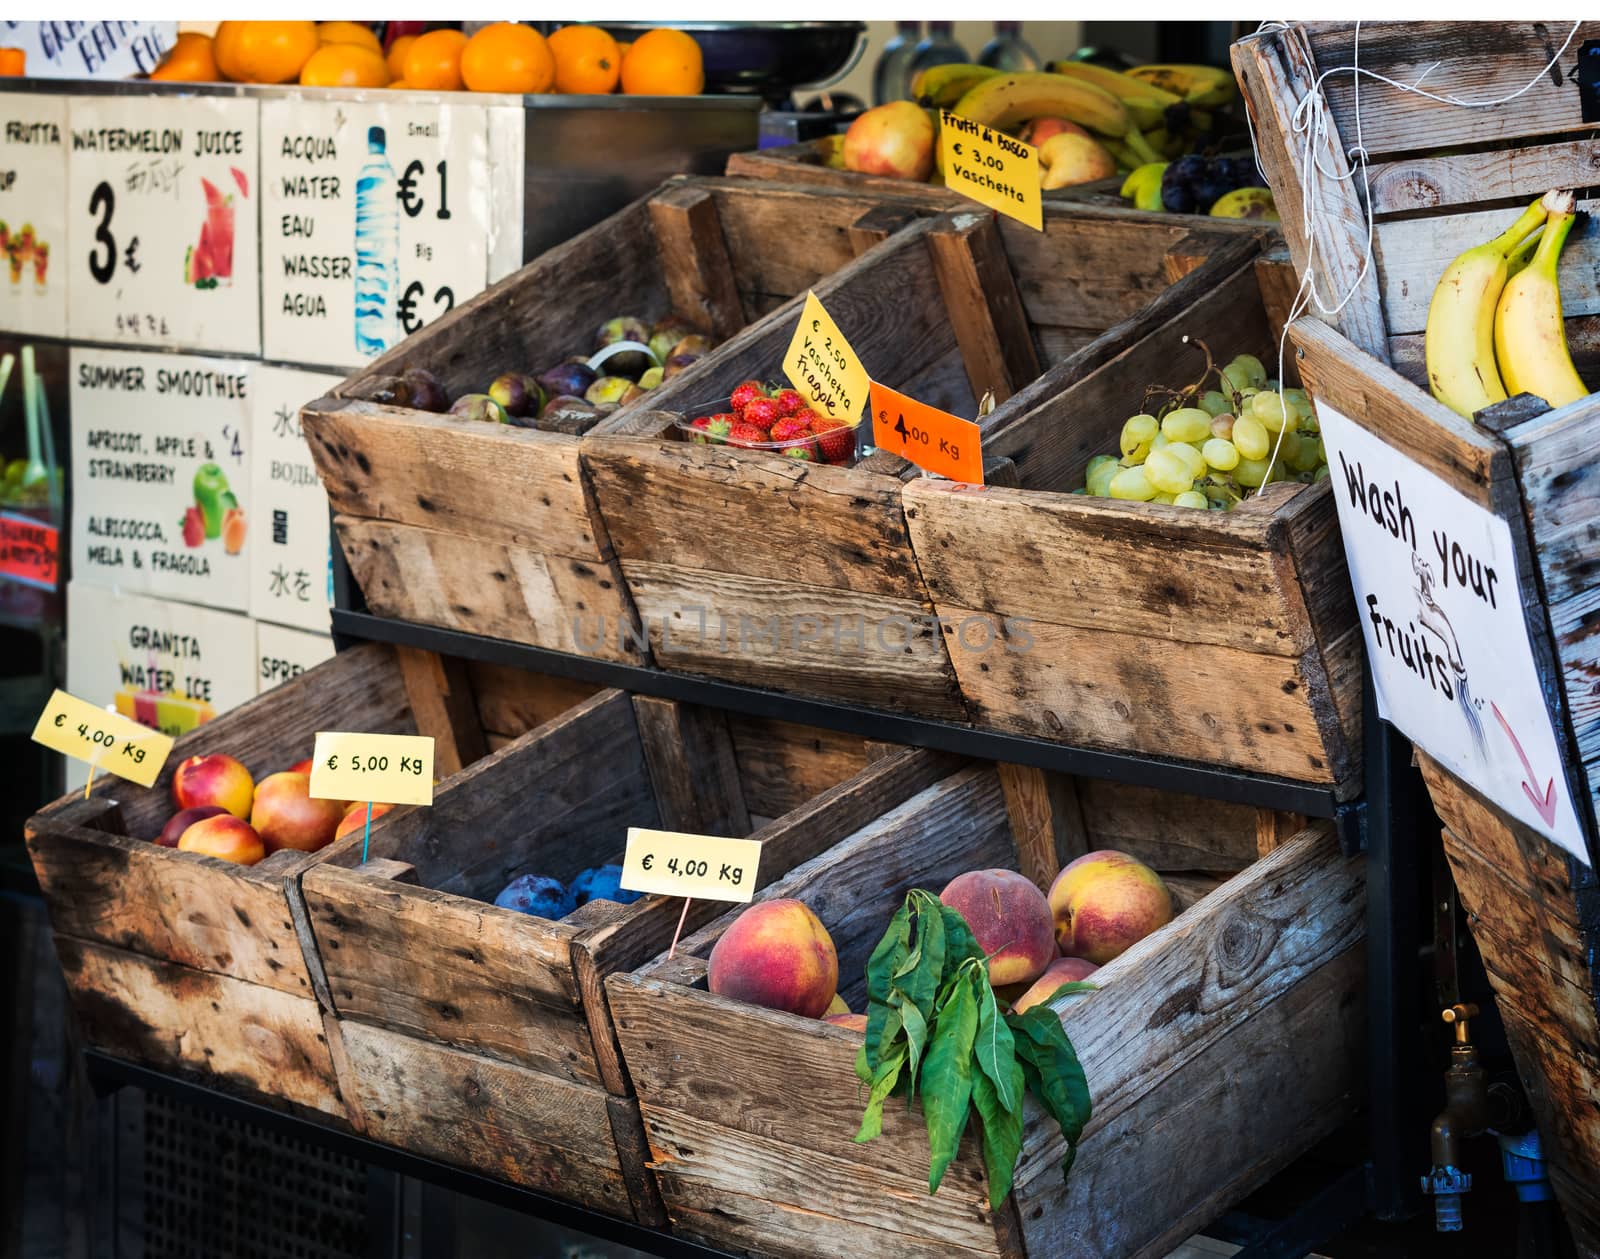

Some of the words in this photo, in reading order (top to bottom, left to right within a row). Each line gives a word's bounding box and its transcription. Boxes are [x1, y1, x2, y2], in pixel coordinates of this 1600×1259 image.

[6, 121, 61, 146] FRUTTA
[408, 121, 439, 138] Small
[72, 128, 184, 153] WATERMELON
[194, 130, 243, 157] JUICE
[281, 136, 337, 163] ACQUA
[953, 143, 963, 155] €
[281, 176, 340, 199] WATER
[953, 163, 1025, 203] Vaschetta
[281, 215, 315, 238] EAU
[282, 255, 352, 279] WASSER
[282, 293, 327, 318] AGUA
[812, 319, 820, 333] €
[79, 364, 146, 391] SUMMER
[157, 369, 248, 398] SMOOTHIE
[796, 353, 836, 416] Fragole
[803, 335, 851, 411] Vaschetta
[879, 410, 889, 425] €
[156, 436, 196, 458] APPLE
[89, 459, 176, 484] STRAWBERRY
[1339, 449, 1417, 551] Wash
[87, 547, 123, 566] MELA
[152, 551, 210, 577] FRAGOLA
[269, 562, 311, 602] 水を
[130, 625, 201, 660] GRANITA
[120, 663, 175, 694] WATER
[186, 676, 211, 703] ICE
[54, 713, 67, 727] €
[327, 755, 338, 771] €
[641, 853, 654, 871] €
[667, 857, 708, 877] 4,00
[718, 863, 743, 886] Kg
